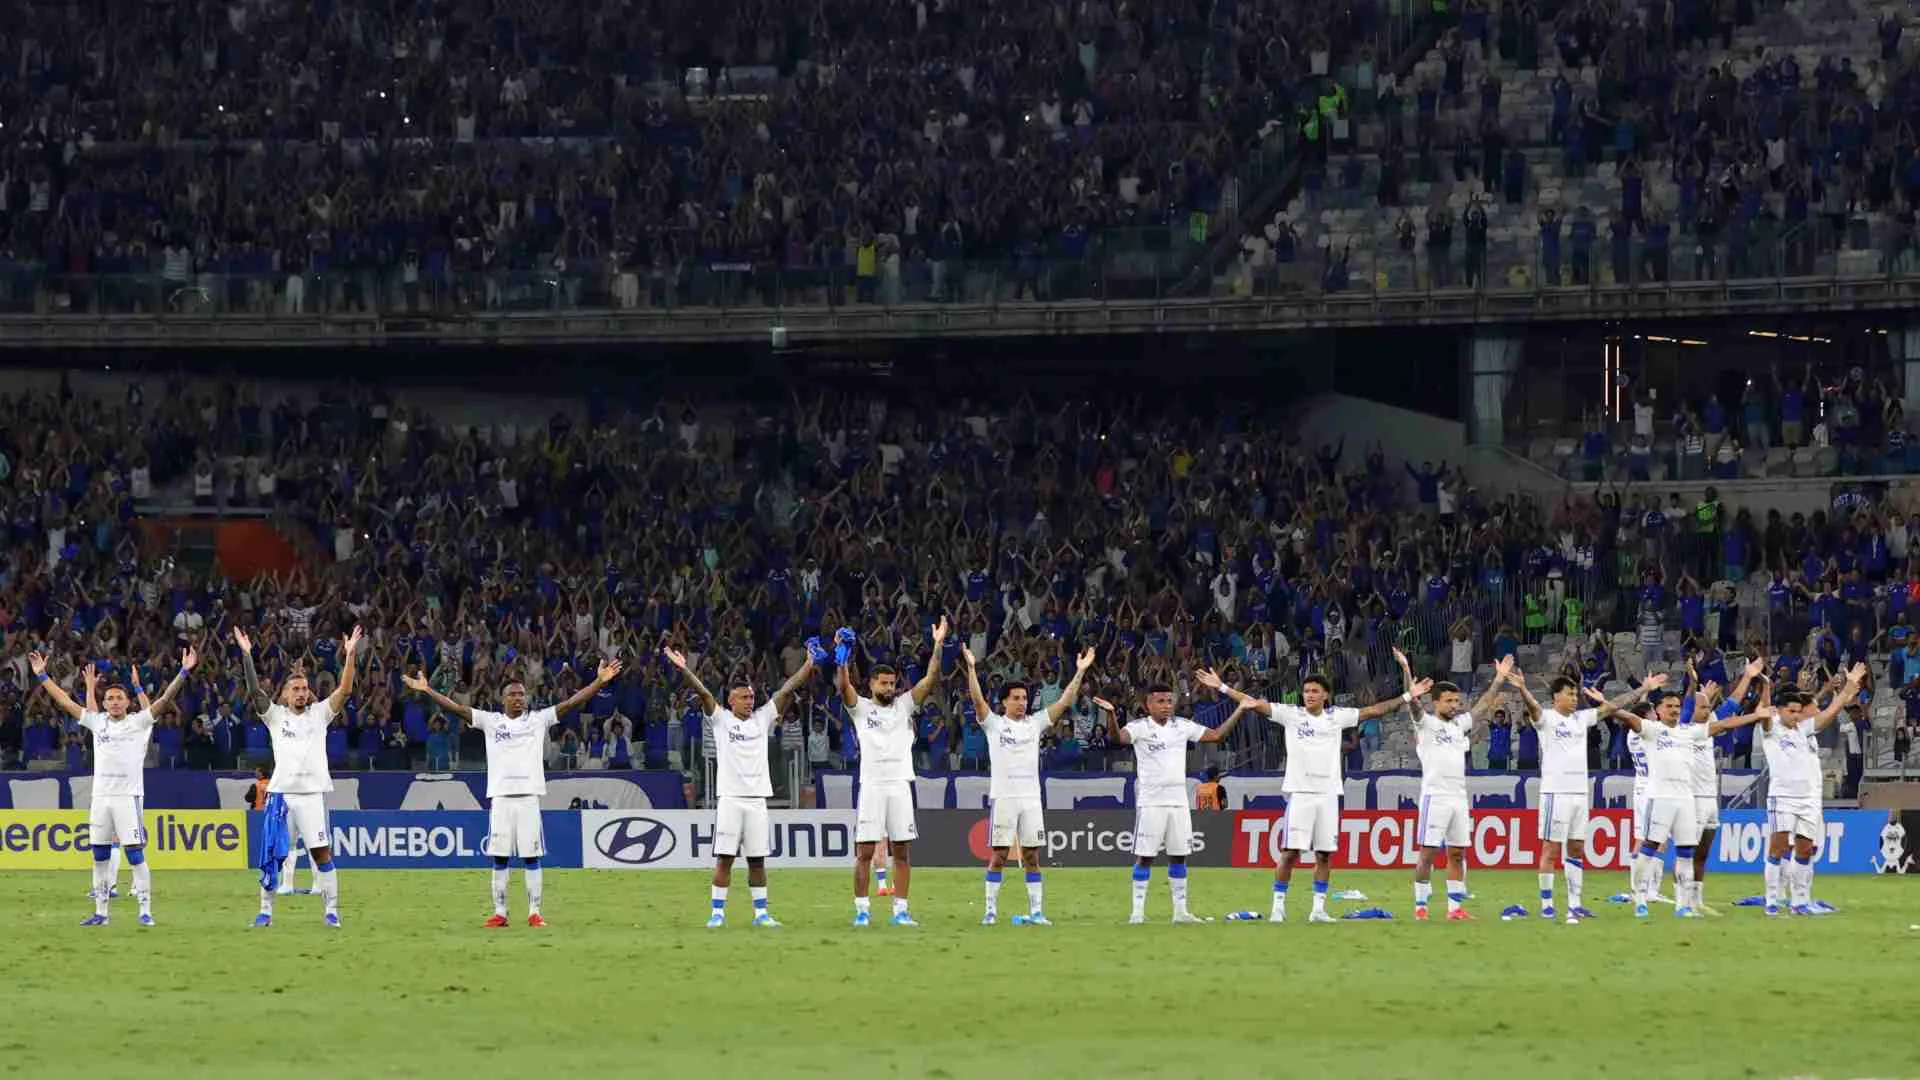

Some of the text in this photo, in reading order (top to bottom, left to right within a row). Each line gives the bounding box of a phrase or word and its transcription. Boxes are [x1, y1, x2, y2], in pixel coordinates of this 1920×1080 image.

[0, 814, 241, 852] erca livre
[1340, 816, 1421, 866] TCL
[1469, 815, 1534, 866] CL
[1561, 816, 1634, 868] CL
